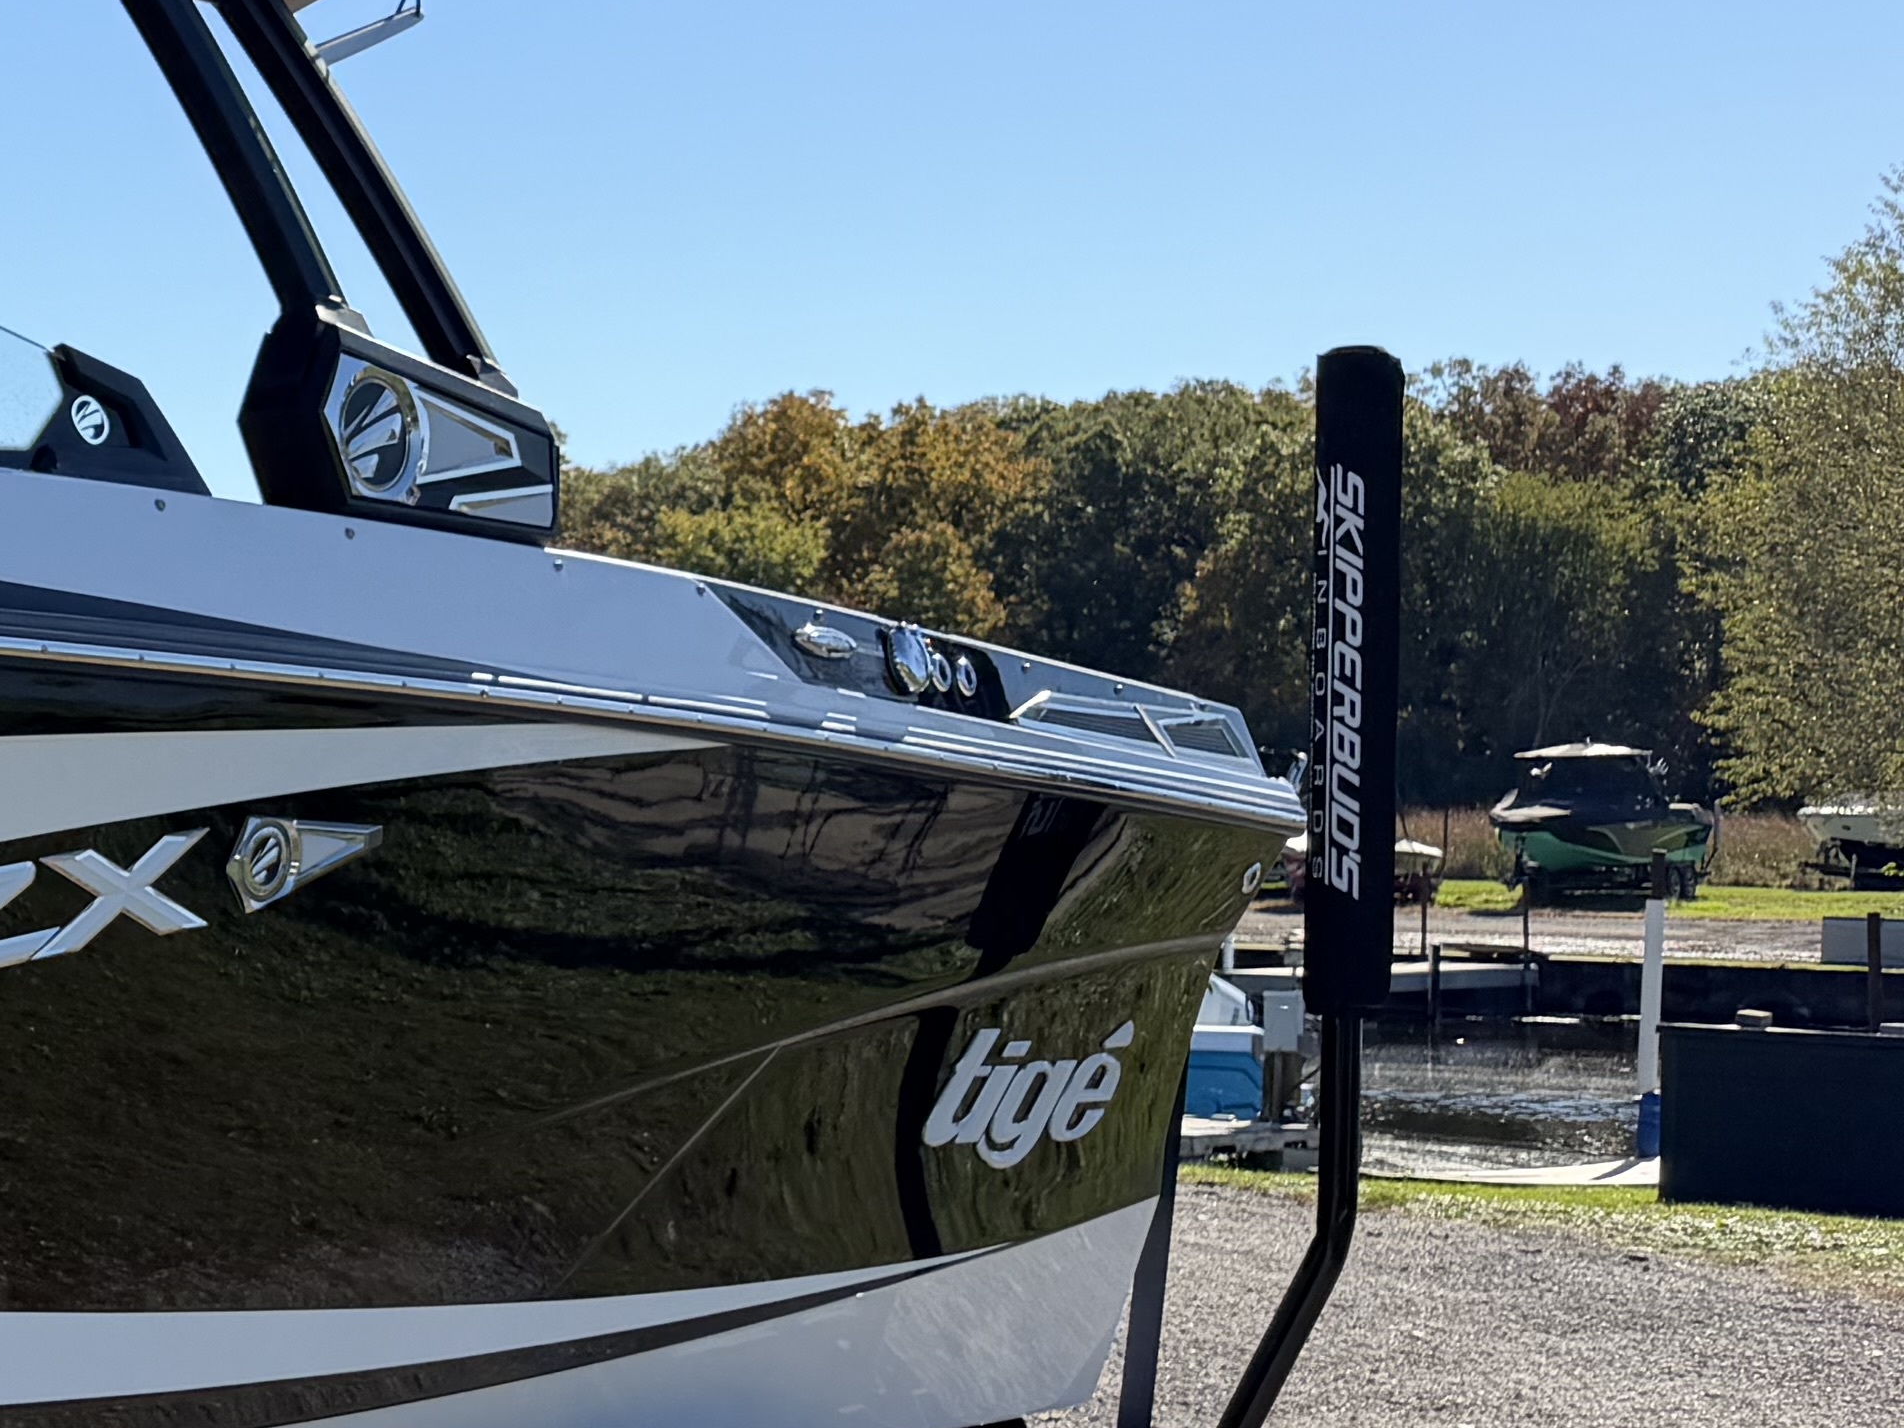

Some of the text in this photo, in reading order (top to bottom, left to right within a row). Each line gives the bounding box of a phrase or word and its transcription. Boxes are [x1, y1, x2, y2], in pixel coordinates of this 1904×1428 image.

[1312, 549, 1328, 879] INBOARDS
[1330, 462, 1366, 901] SKIPPERBUD'S
[922, 1019, 1136, 1170] tigé
